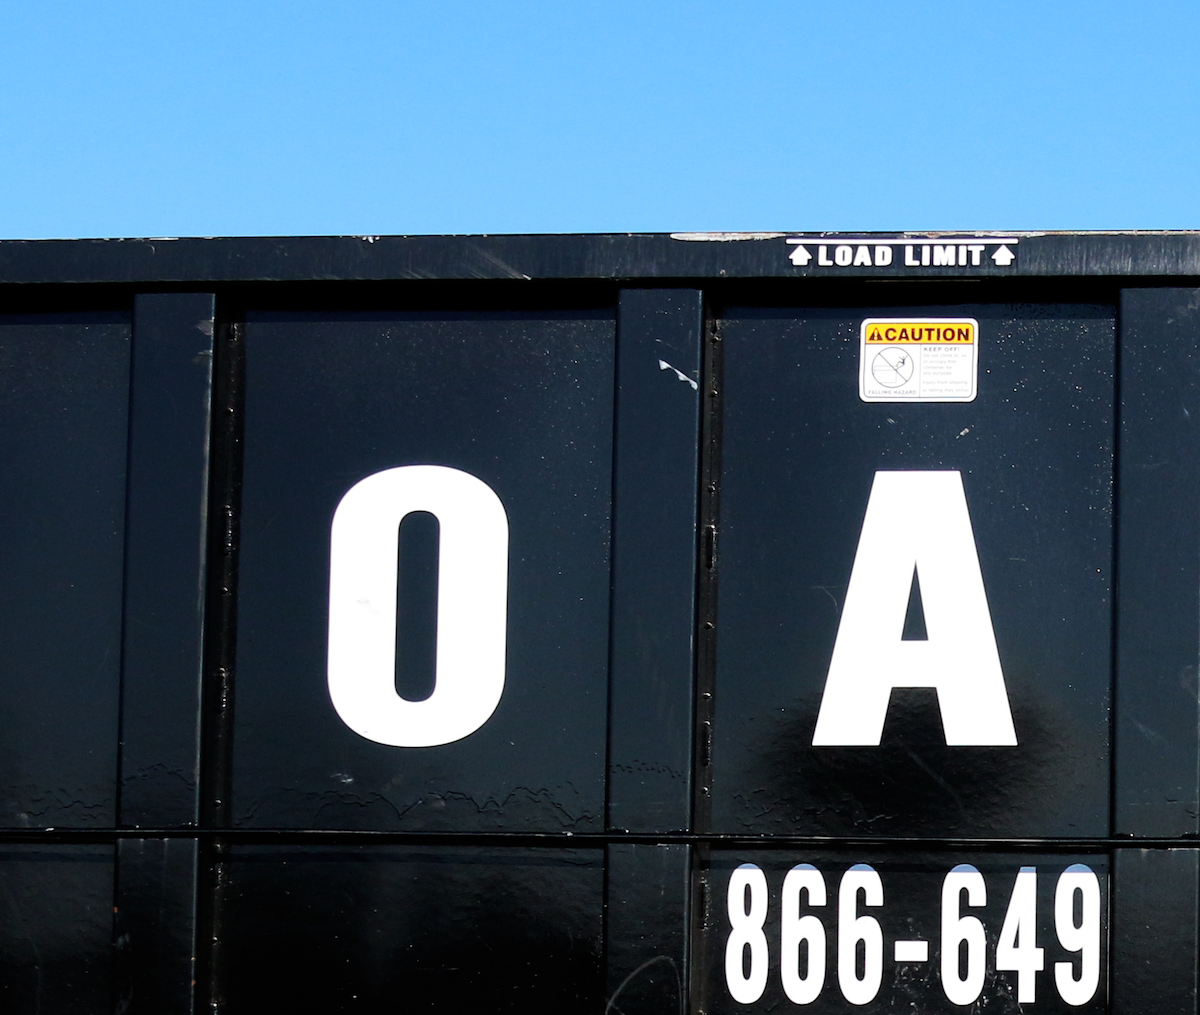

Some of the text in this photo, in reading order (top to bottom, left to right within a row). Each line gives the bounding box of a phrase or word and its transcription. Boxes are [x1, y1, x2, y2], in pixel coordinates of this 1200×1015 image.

[818, 245, 986, 266] LOAD LIMIT
[885, 327, 970, 341] CAUTION
[726, 864, 1100, 1005] 866-649
